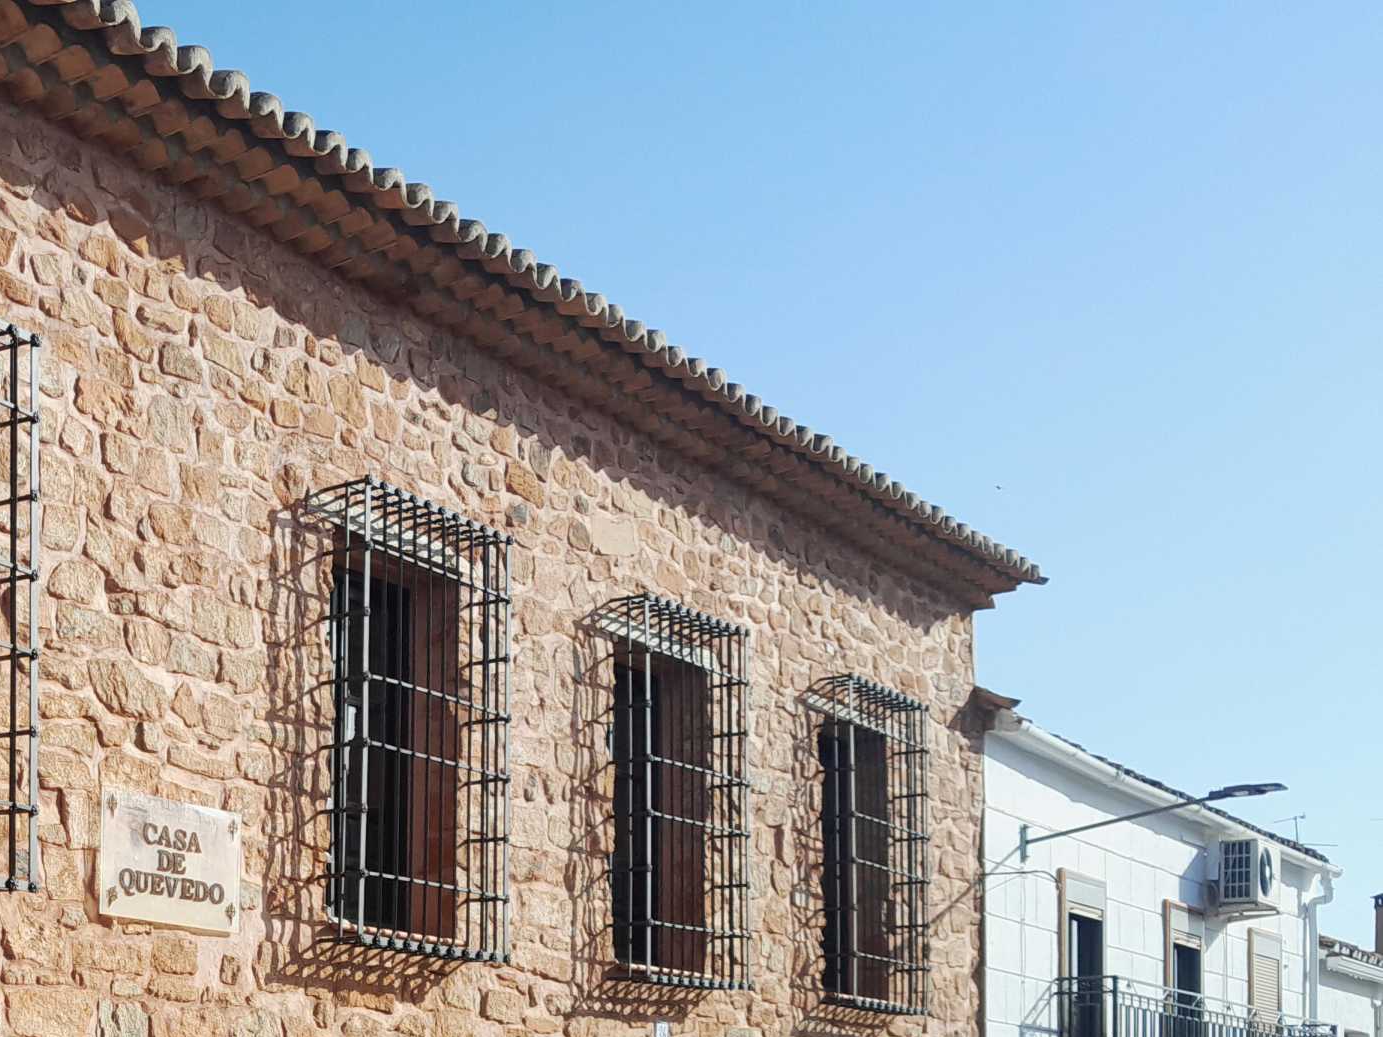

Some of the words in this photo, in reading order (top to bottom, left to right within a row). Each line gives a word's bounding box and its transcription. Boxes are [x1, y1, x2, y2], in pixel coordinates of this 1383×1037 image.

[143, 822, 202, 854] CASA
[156, 849, 186, 875] DE
[118, 867, 225, 905] QUEVEDO
